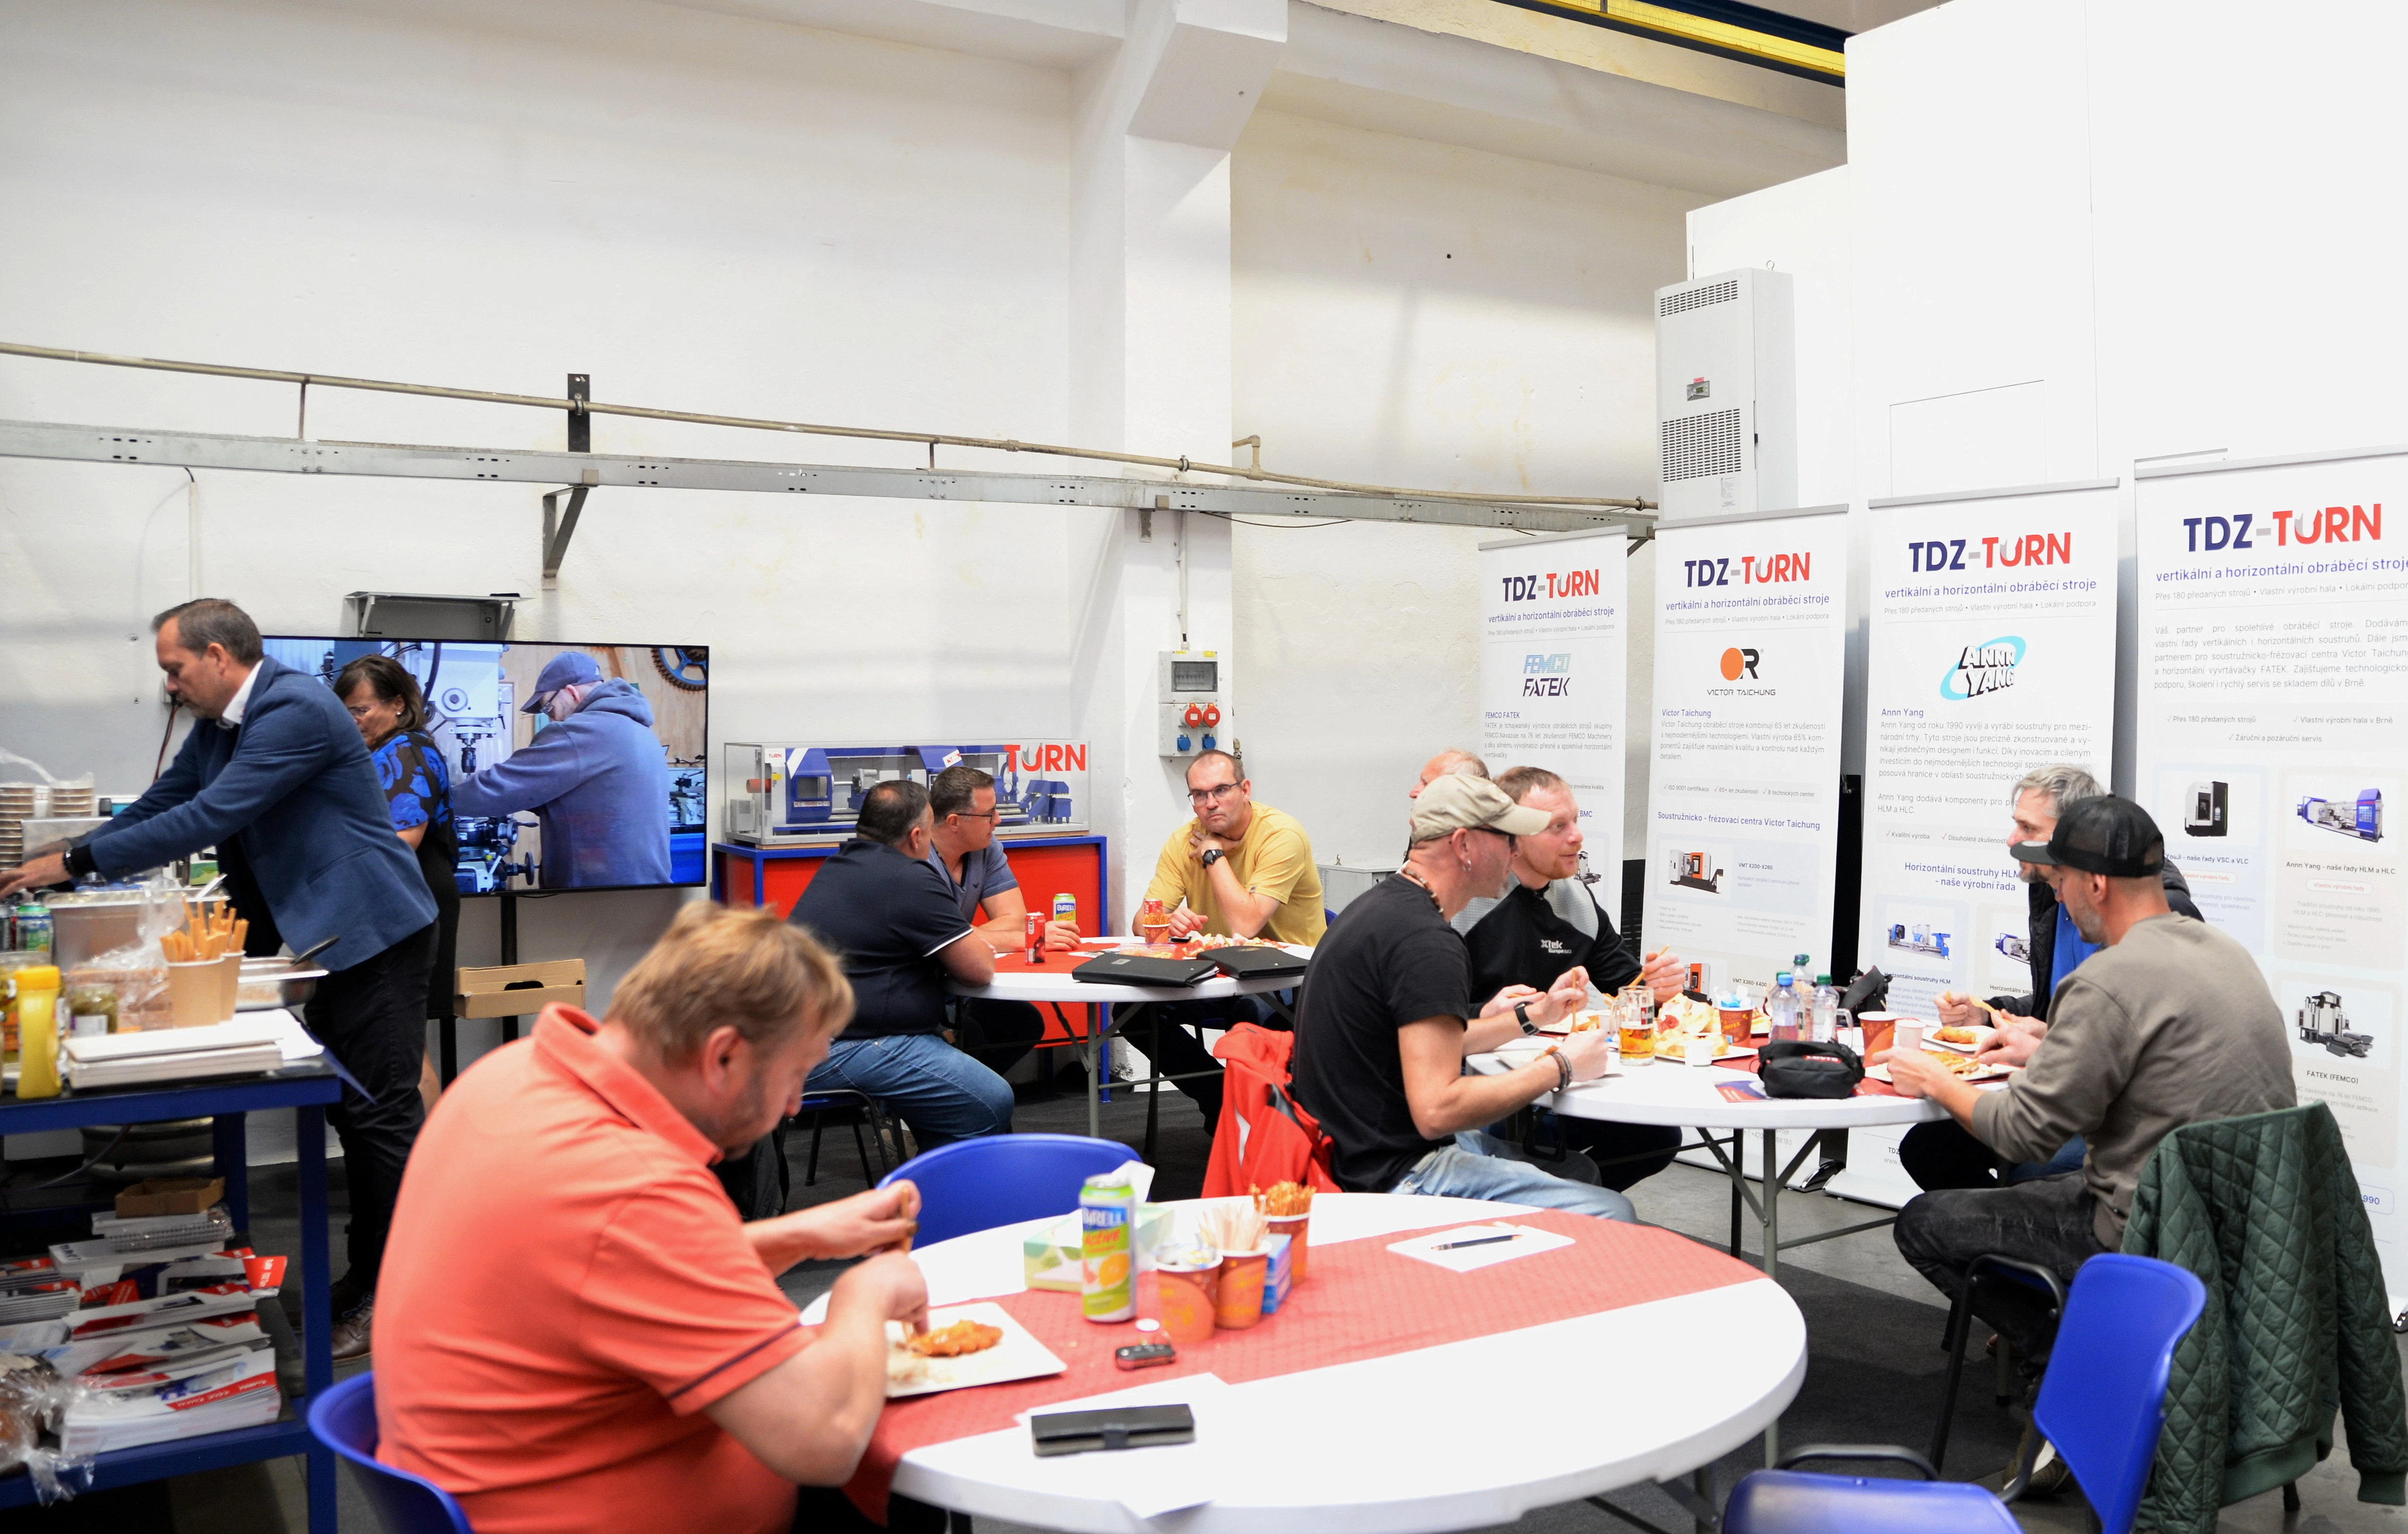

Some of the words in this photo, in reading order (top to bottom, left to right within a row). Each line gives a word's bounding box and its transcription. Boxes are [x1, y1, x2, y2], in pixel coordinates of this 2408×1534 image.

[2184, 503, 2381, 552] TDZ-TURN
[1908, 532, 2071, 572] TDZ-TURN
[1684, 552, 1810, 587] TDZ-TURN
[2156, 568, 2212, 581] vertikální
[2215, 570, 2222, 578] a
[2226, 562, 2304, 577] horizontální
[2307, 559, 2368, 573] obráběcí
[1503, 569, 1599, 602] TDZ-TURN
[1884, 586, 1932, 597] vertikální
[1943, 582, 2007, 595] horizontální
[2009, 580, 2059, 592] obráběcí
[2062, 578, 2096, 591] stroje
[2187, 590, 2226, 599] předaných
[2228, 587, 2250, 597] strojů
[2259, 587, 2285, 595] Vlastní
[2287, 585, 2317, 595] výrobní
[2345, 582, 2374, 591] Lokální
[1665, 600, 1703, 610] vertikální
[1711, 597, 1761, 608] horizontální
[1762, 595, 1801, 605] obráběcí
[1803, 593, 1829, 605] stroje
[1488, 613, 1516, 622] vertikální
[1522, 610, 1562, 620] horizontální
[1562, 607, 1592, 617] obráběcí
[1593, 606, 1614, 617] stroje
[2154, 626, 2168, 634] Váš
[2176, 626, 2204, 634] partner
[2234, 623, 2274, 632] spolehlivé
[2283, 621, 2320, 630] obráběcí
[2329, 620, 2355, 629] stroje.
[2365, 618, 2408, 627] Dodávám
[2154, 639, 2178, 647] vlastní
[2181, 639, 2198, 648] řady
[2202, 638, 2247, 646] vertikálních
[2257, 636, 2314, 644] horizontálních
[2318, 633, 2362, 643] soustruhů.
[2367, 634, 2387, 642] Dále
[2391, 633, 2408, 643] jsm
[1524, 653, 1571, 674] FEMCO
[2154, 654, 2192, 663] partnerem
[2211, 651, 2307, 660] soustružnicko-frézovací
[2341, 649, 2367, 658] Victor
[2162, 667, 2205, 675] horizontální
[2208, 666, 2256, 676] vyvrtávačky
[2260, 665, 2289, 673] FATEK.
[2293, 665, 2341, 674] Zajišťujeme
[1523, 677, 1570, 697] FATEK
[1966, 668, 2015, 698] YANG
[2154, 682, 2186, 690] podporu,
[2188, 680, 2214, 688] školení
[2220, 680, 2244, 690] rychlý
[2320, 678, 2334, 687] dílů
[2344, 679, 2366, 687] Brně.
[1680, 709, 1711, 718] Taichung
[1903, 709, 1924, 718] Yang
[2237, 716, 2256, 724] strojů
[1898, 721, 1915, 730] Yang
[1965, 722, 1983, 731] vyvíjí
[1990, 722, 2014, 731] vyrábí
[2015, 723, 2052, 732] soustruhy
[1004, 744, 1086, 772] TURN
[1657, 811, 1703, 821] Soustružnicko
[1708, 814, 1739, 823] frézovací
[1764, 818, 1785, 826] Victor
[1786, 819, 1820, 831] Taichung
[1904, 862, 1956, 874] Horizontální
[1957, 867, 1999, 879] soustruhy
[2343, 865, 2358, 873] řady
[1941, 878, 1961, 887] naše
[1962, 879, 1995, 889] výrobní
[1996, 882, 2016, 891] řada
[2307, 1070, 2327, 1078] FATEK
[2329, 1073, 2358, 1084] (FEMCO)
[2362, 1195, 2380, 1205] 990
